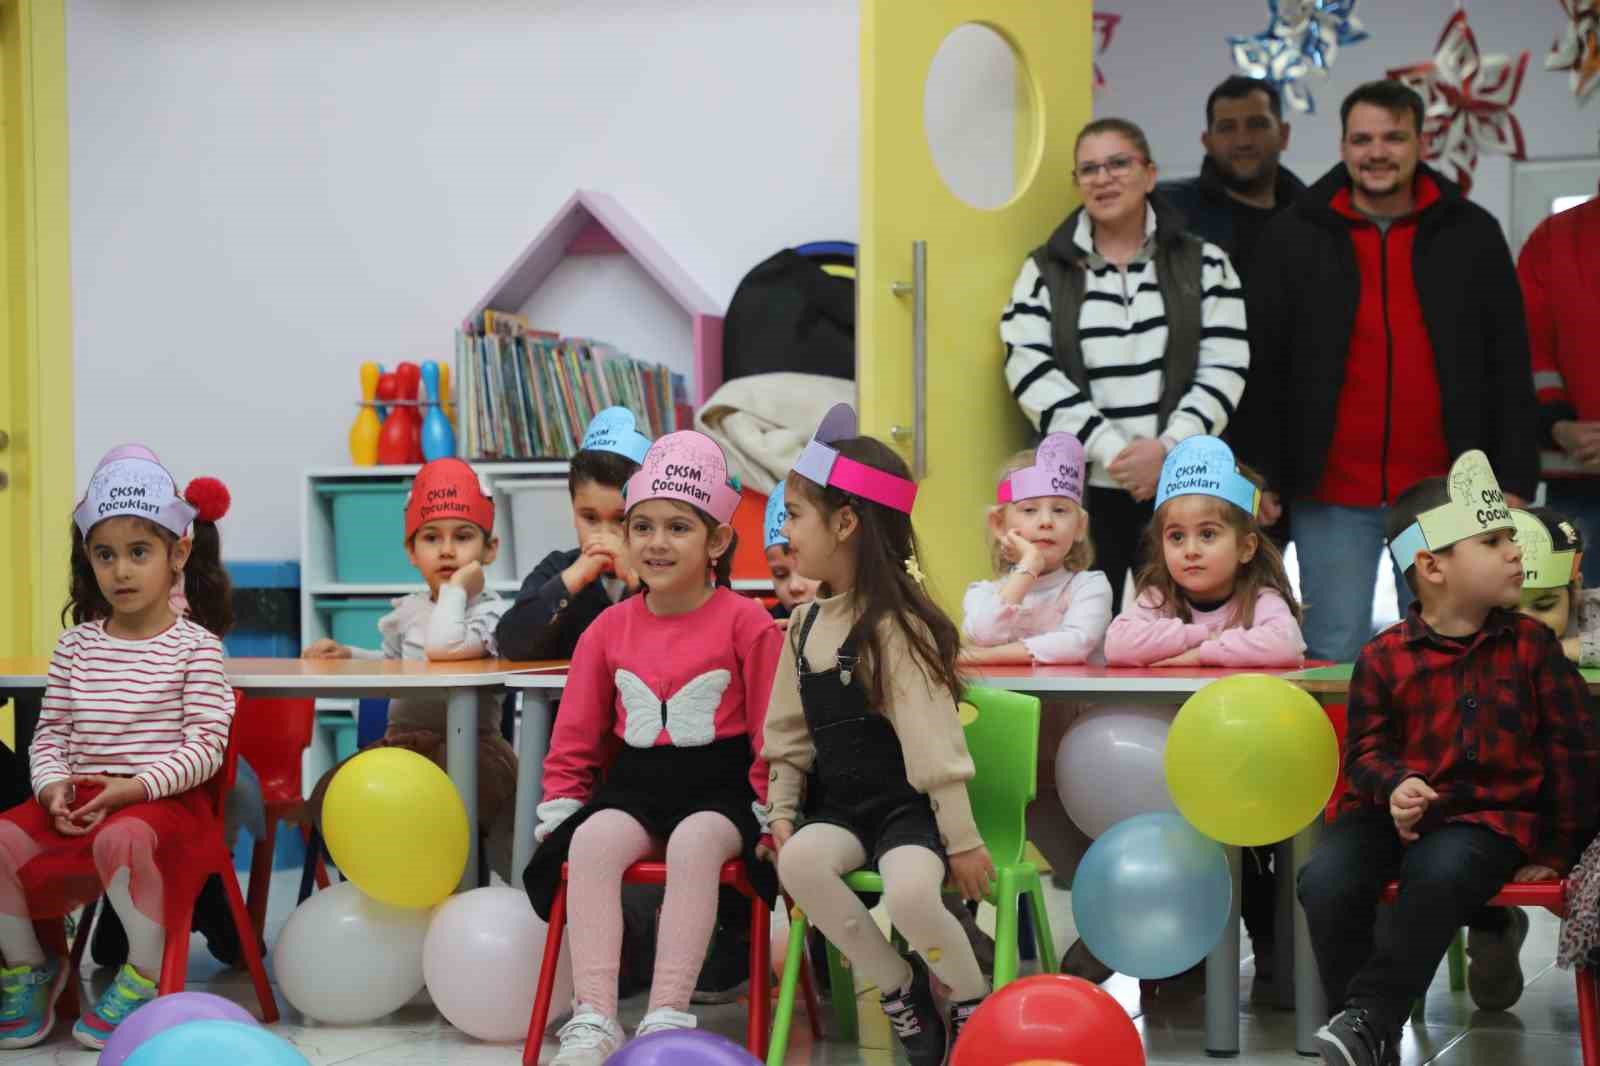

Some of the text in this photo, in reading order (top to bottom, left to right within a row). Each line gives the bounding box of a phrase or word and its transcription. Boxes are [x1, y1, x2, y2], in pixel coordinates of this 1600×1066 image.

[664, 464, 702, 481] ÇKSM
[1176, 464, 1207, 480] ÇKSM
[110, 486, 146, 501] ÇKSM
[427, 485, 458, 504] ÇKSM
[651, 479, 711, 504] Çocukları
[1166, 478, 1220, 496] Çocukları
[98, 499, 160, 516] Çocukları
[421, 501, 470, 520] Çocukları
